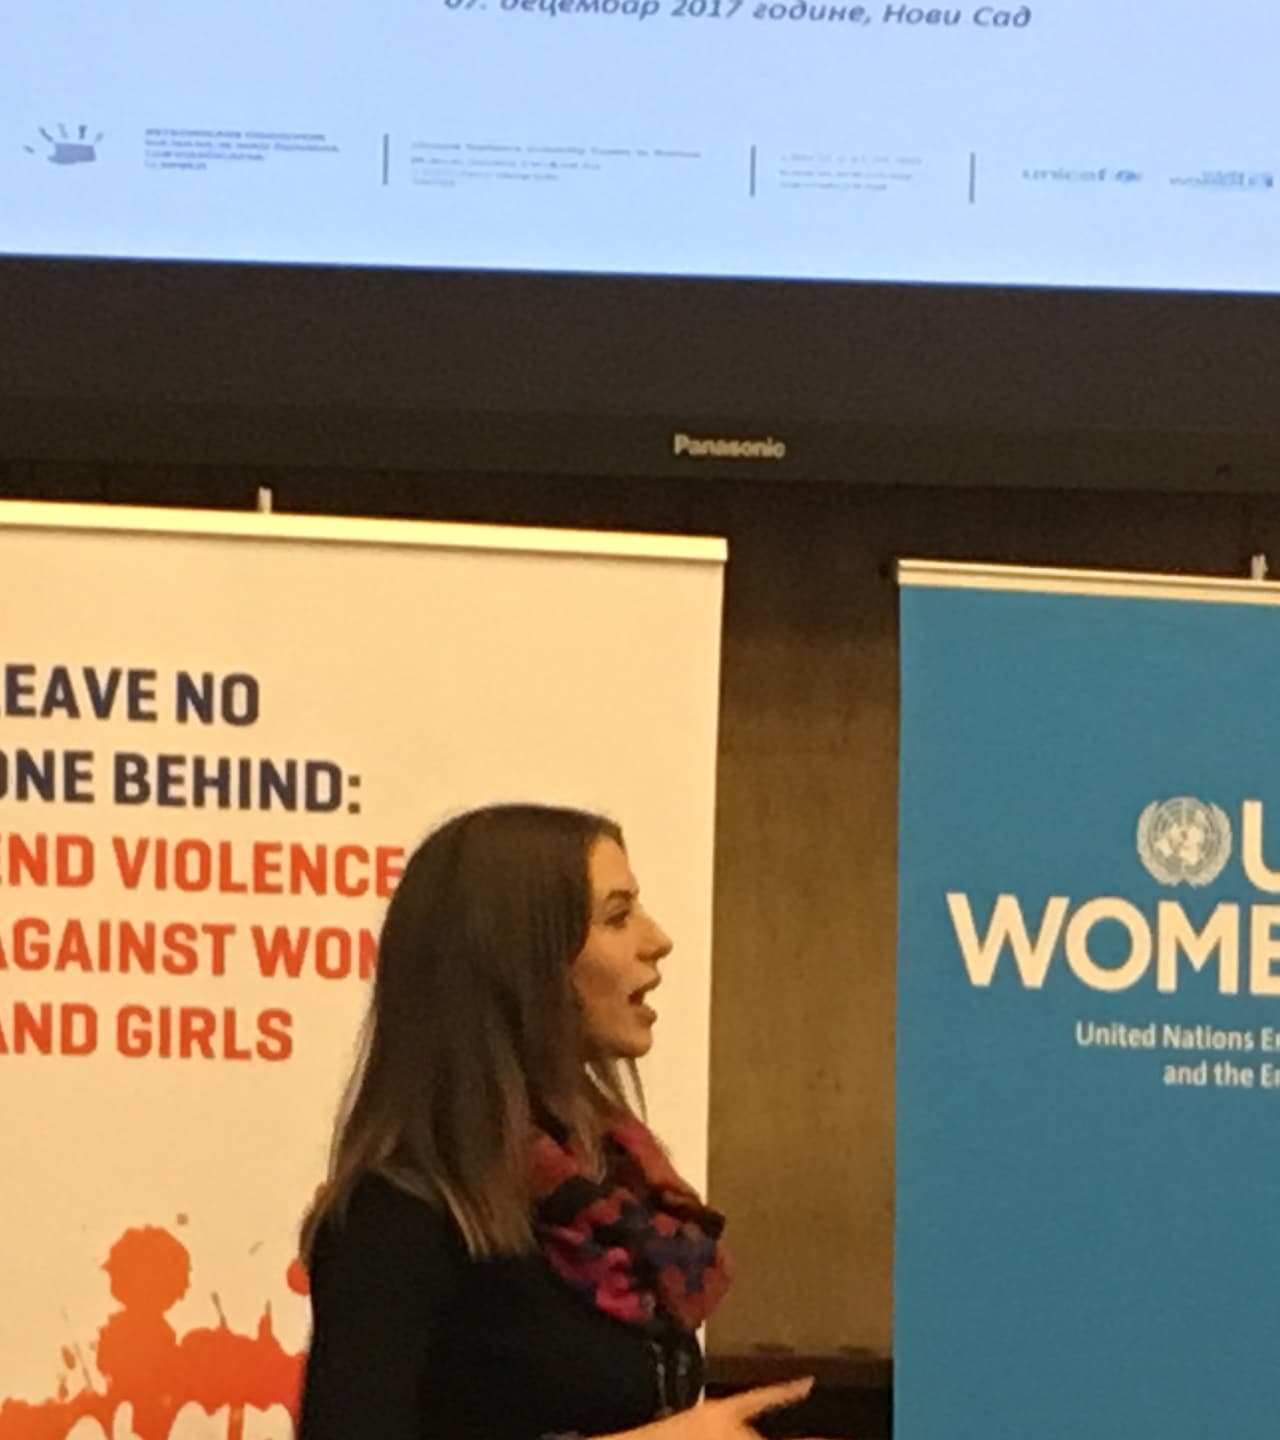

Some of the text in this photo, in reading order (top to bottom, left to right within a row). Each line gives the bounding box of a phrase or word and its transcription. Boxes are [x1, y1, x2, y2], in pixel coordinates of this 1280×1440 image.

[882, 4, 961, 26] Нови
[972, 6, 1032, 28] Сад
[674, 433, 787, 459] Panasonic
[176, 671, 260, 727] NO
[113, 752, 361, 814] BEHIND:
[112, 836, 405, 898] VIOLENCE
[115, 1004, 294, 1063] GIRLS
[1075, 1021, 1156, 1048] United
[1162, 1024, 1254, 1050] Nations
[1163, 1059, 1207, 1086] and
[1214, 1060, 1254, 1088] the
